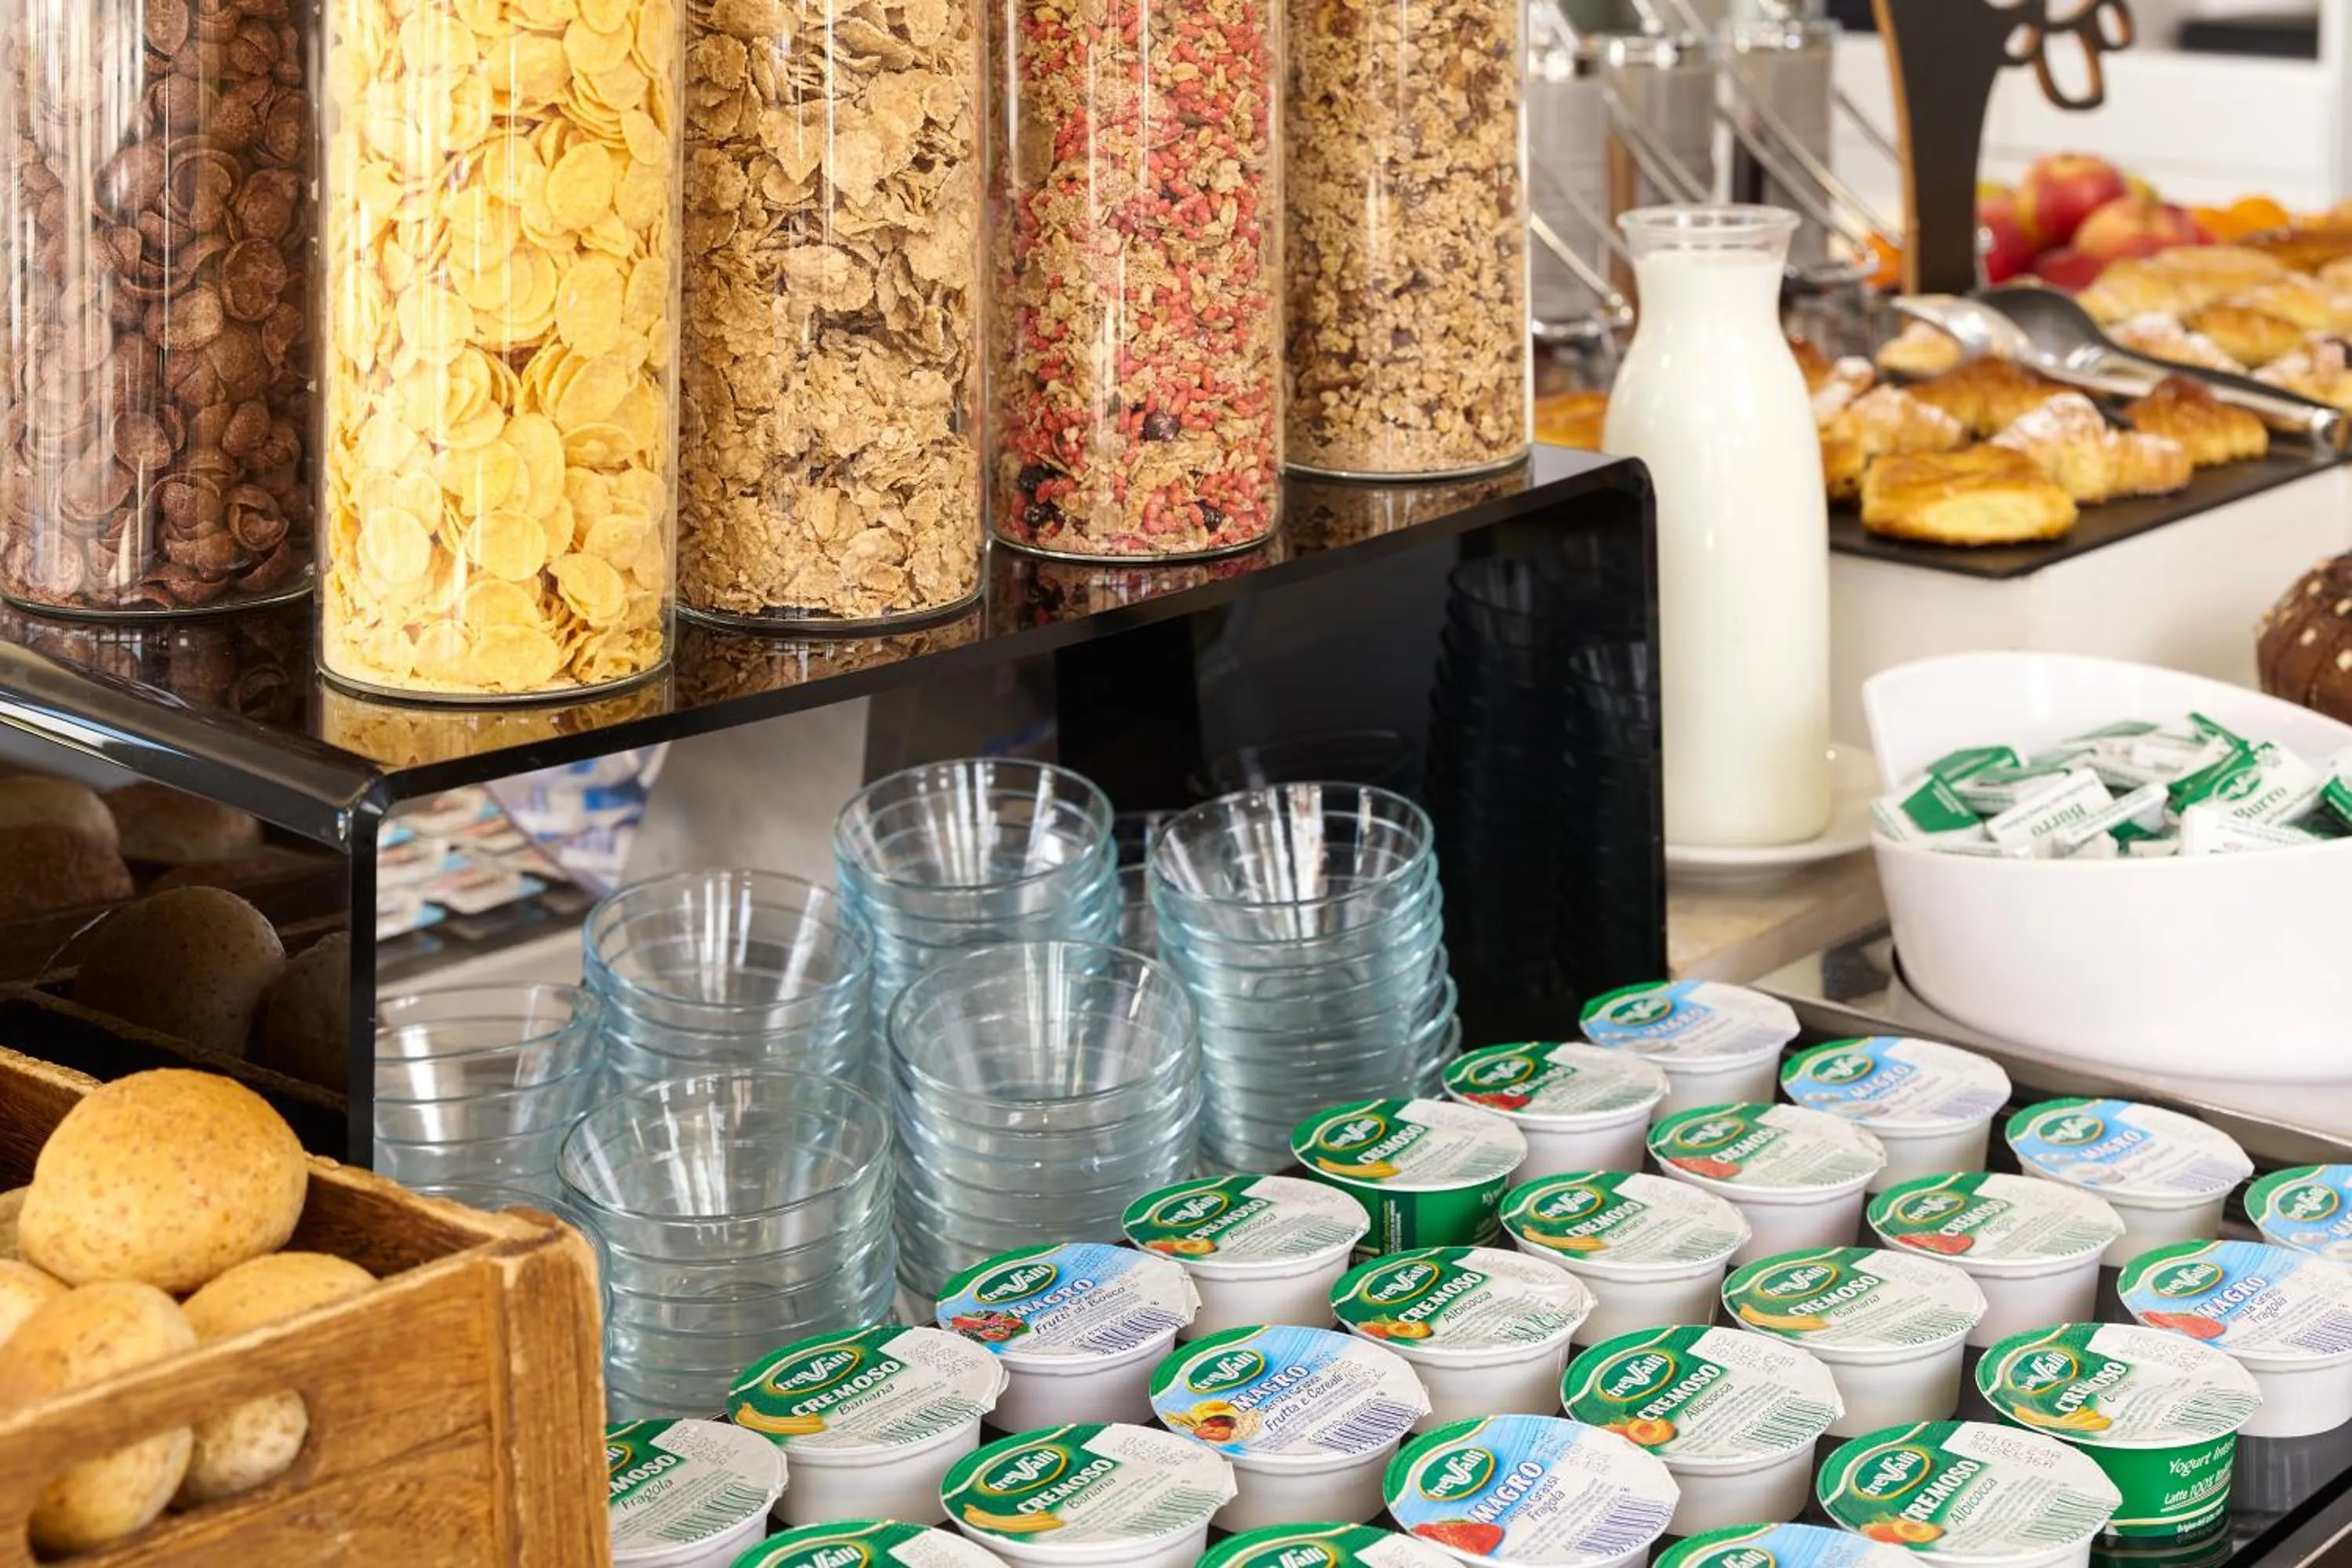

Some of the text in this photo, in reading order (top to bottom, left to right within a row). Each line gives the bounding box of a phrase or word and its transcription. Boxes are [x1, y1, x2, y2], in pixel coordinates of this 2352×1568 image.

[2233, 786, 2287, 818] Burro
[1356, 1124, 1425, 1163] CREMOSO
[1185, 1199, 1269, 1240] CREMOSO
[1566, 1201, 1644, 1236] CREMOSO
[1940, 1199, 2008, 1236] CREMOSO
[1007, 1279, 1095, 1318] MAGRO
[1399, 1272, 1483, 1323] CREMOSO
[1443, 1290, 1493, 1323] Albicocca
[1788, 1275, 1880, 1316] CREMOSO
[1832, 1292, 1881, 1318] Banana
[2195, 1277, 2268, 1319] MAGRO
[2247, 1297, 2287, 1323] Fragola
[1035, 1312, 1069, 1334] Frutti
[791, 1361, 901, 1416] CREMOSO
[839, 1382, 895, 1415] Banana
[1230, 1366, 1310, 1413] MAGRO
[1637, 1363, 1722, 1421] CREMOSO
[1685, 1382, 1734, 1420] Albicocca
[1265, 1405, 1299, 1432] Frutta
[609, 1454, 677, 1495] MOSO
[2169, 1450, 2212, 1477] Yogurt
[621, 1478, 673, 1511] Fragola
[1017, 1459, 1115, 1514] CREMOSO
[1066, 1476, 1116, 1510] Banana
[1468, 1461, 1544, 1523] MAGRO
[1901, 1461, 1981, 1523] CREMOSO
[1950, 1478, 1997, 1525] Albicocca
[2164, 1489, 2188, 1504] Latte
[1527, 1490, 1565, 1522] Fragola
